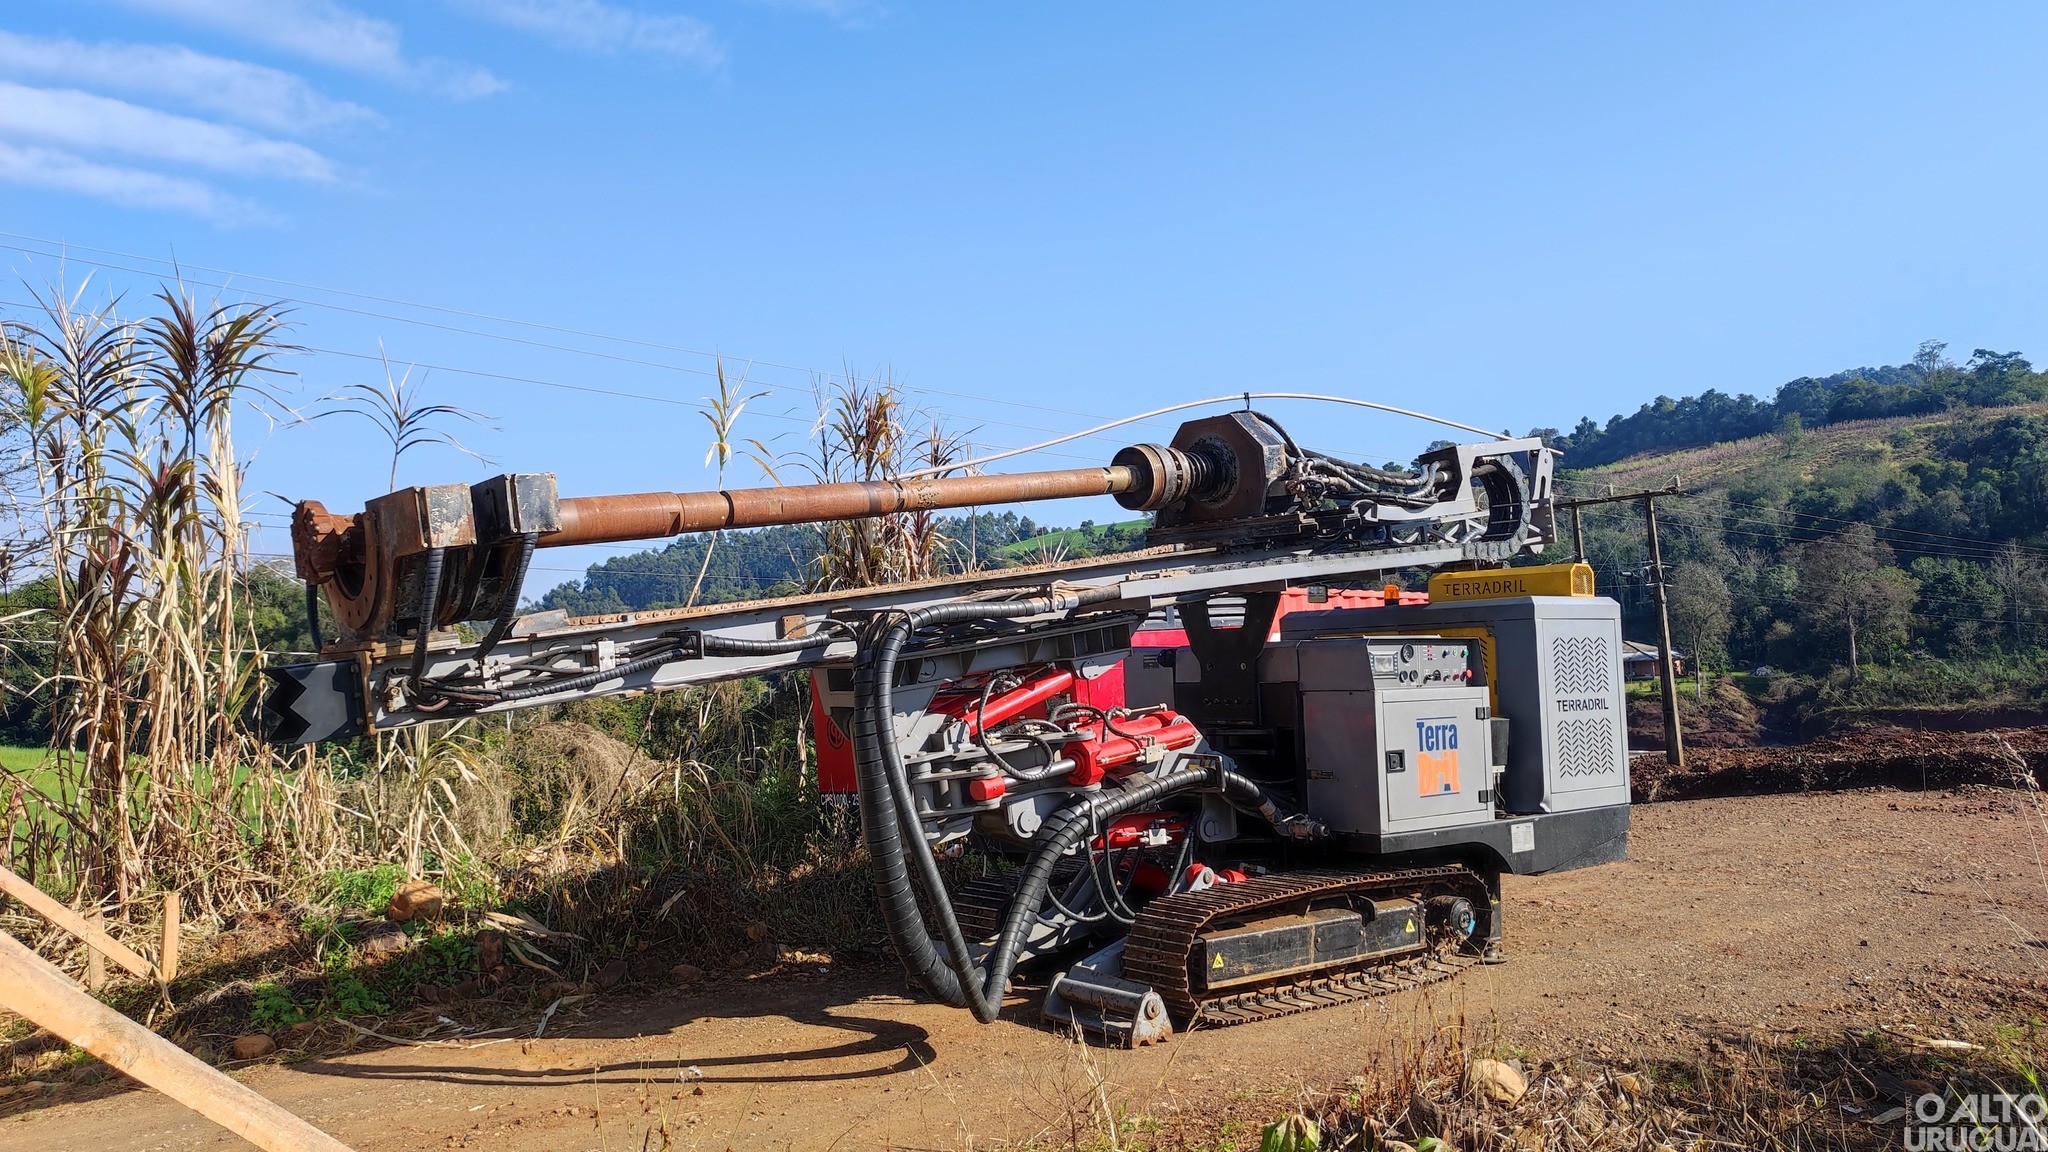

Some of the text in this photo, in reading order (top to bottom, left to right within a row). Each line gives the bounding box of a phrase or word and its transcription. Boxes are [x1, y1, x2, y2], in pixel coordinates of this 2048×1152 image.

[1444, 580, 1526, 596] TERRADRIL
[1556, 698, 1609, 712] TERRADRIL
[1417, 722, 1458, 751] Terra
